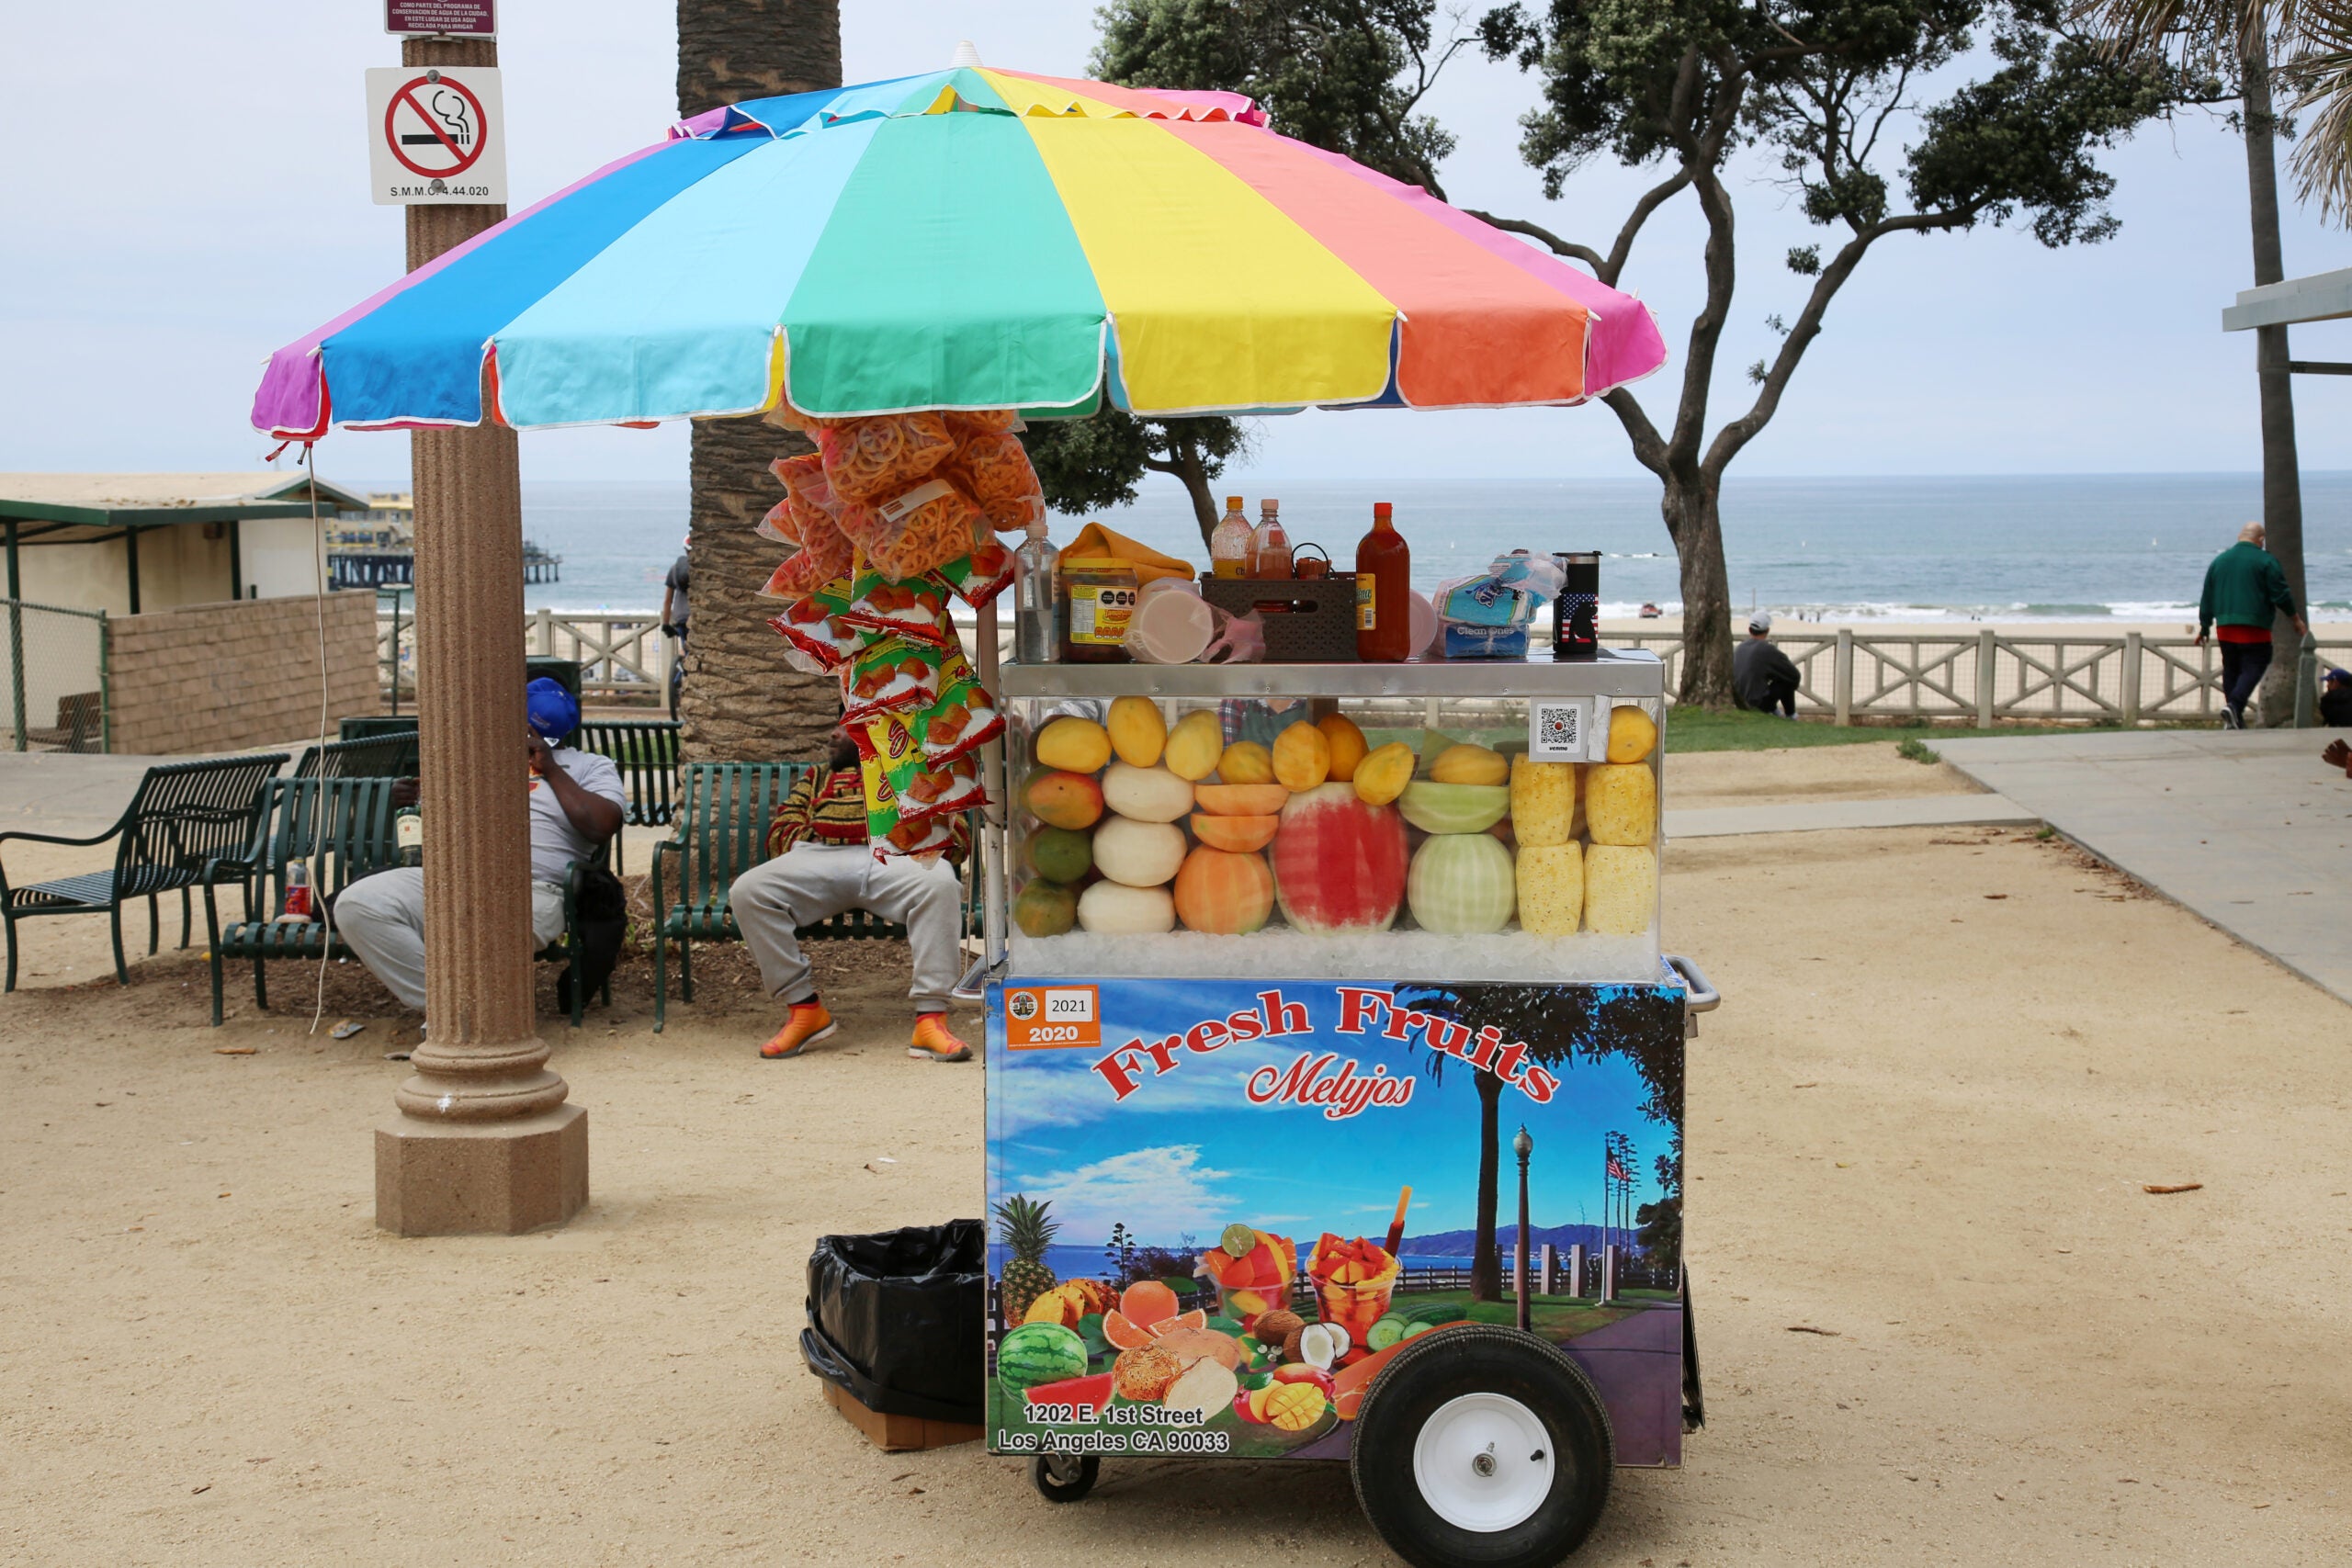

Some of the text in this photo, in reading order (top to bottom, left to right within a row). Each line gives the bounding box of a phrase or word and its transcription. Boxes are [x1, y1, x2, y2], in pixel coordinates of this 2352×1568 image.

[442, 186, 489, 196] 4.44.020
[1456, 626, 1515, 636] Clean Ones
[1052, 999, 1086, 1012] 2021
[1029, 1026, 1079, 1043] 2020
[1091, 987, 1561, 1103] Fresh Fruits
[1245, 1052, 1416, 1121] Melyjos
[1023, 1404, 1204, 1425] 1202 E. 1st Street
[999, 1430, 1229, 1452] Los Angeles CA 90033
